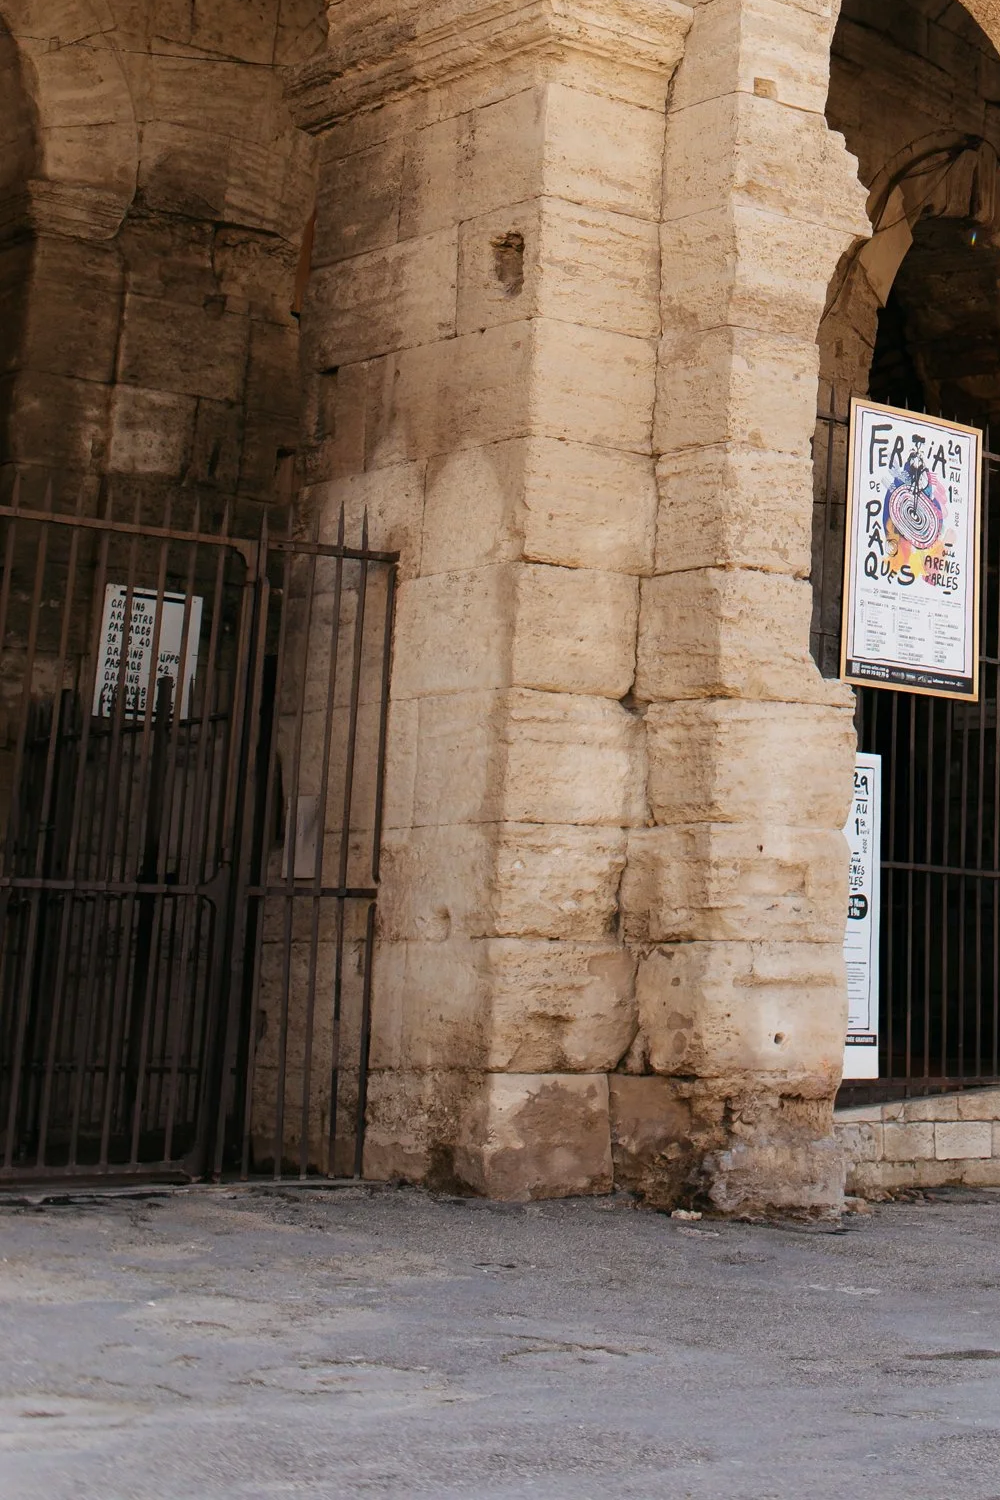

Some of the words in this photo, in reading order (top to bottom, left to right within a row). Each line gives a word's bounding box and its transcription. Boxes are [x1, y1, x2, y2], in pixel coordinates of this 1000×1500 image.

[948, 439, 962, 464] 29
[949, 473, 961, 483] AU
[869, 480, 881, 493] DE
[924, 555, 961, 575] ARENES
[108, 622, 151, 636] PASAGES
[855, 803, 867, 814] AU
